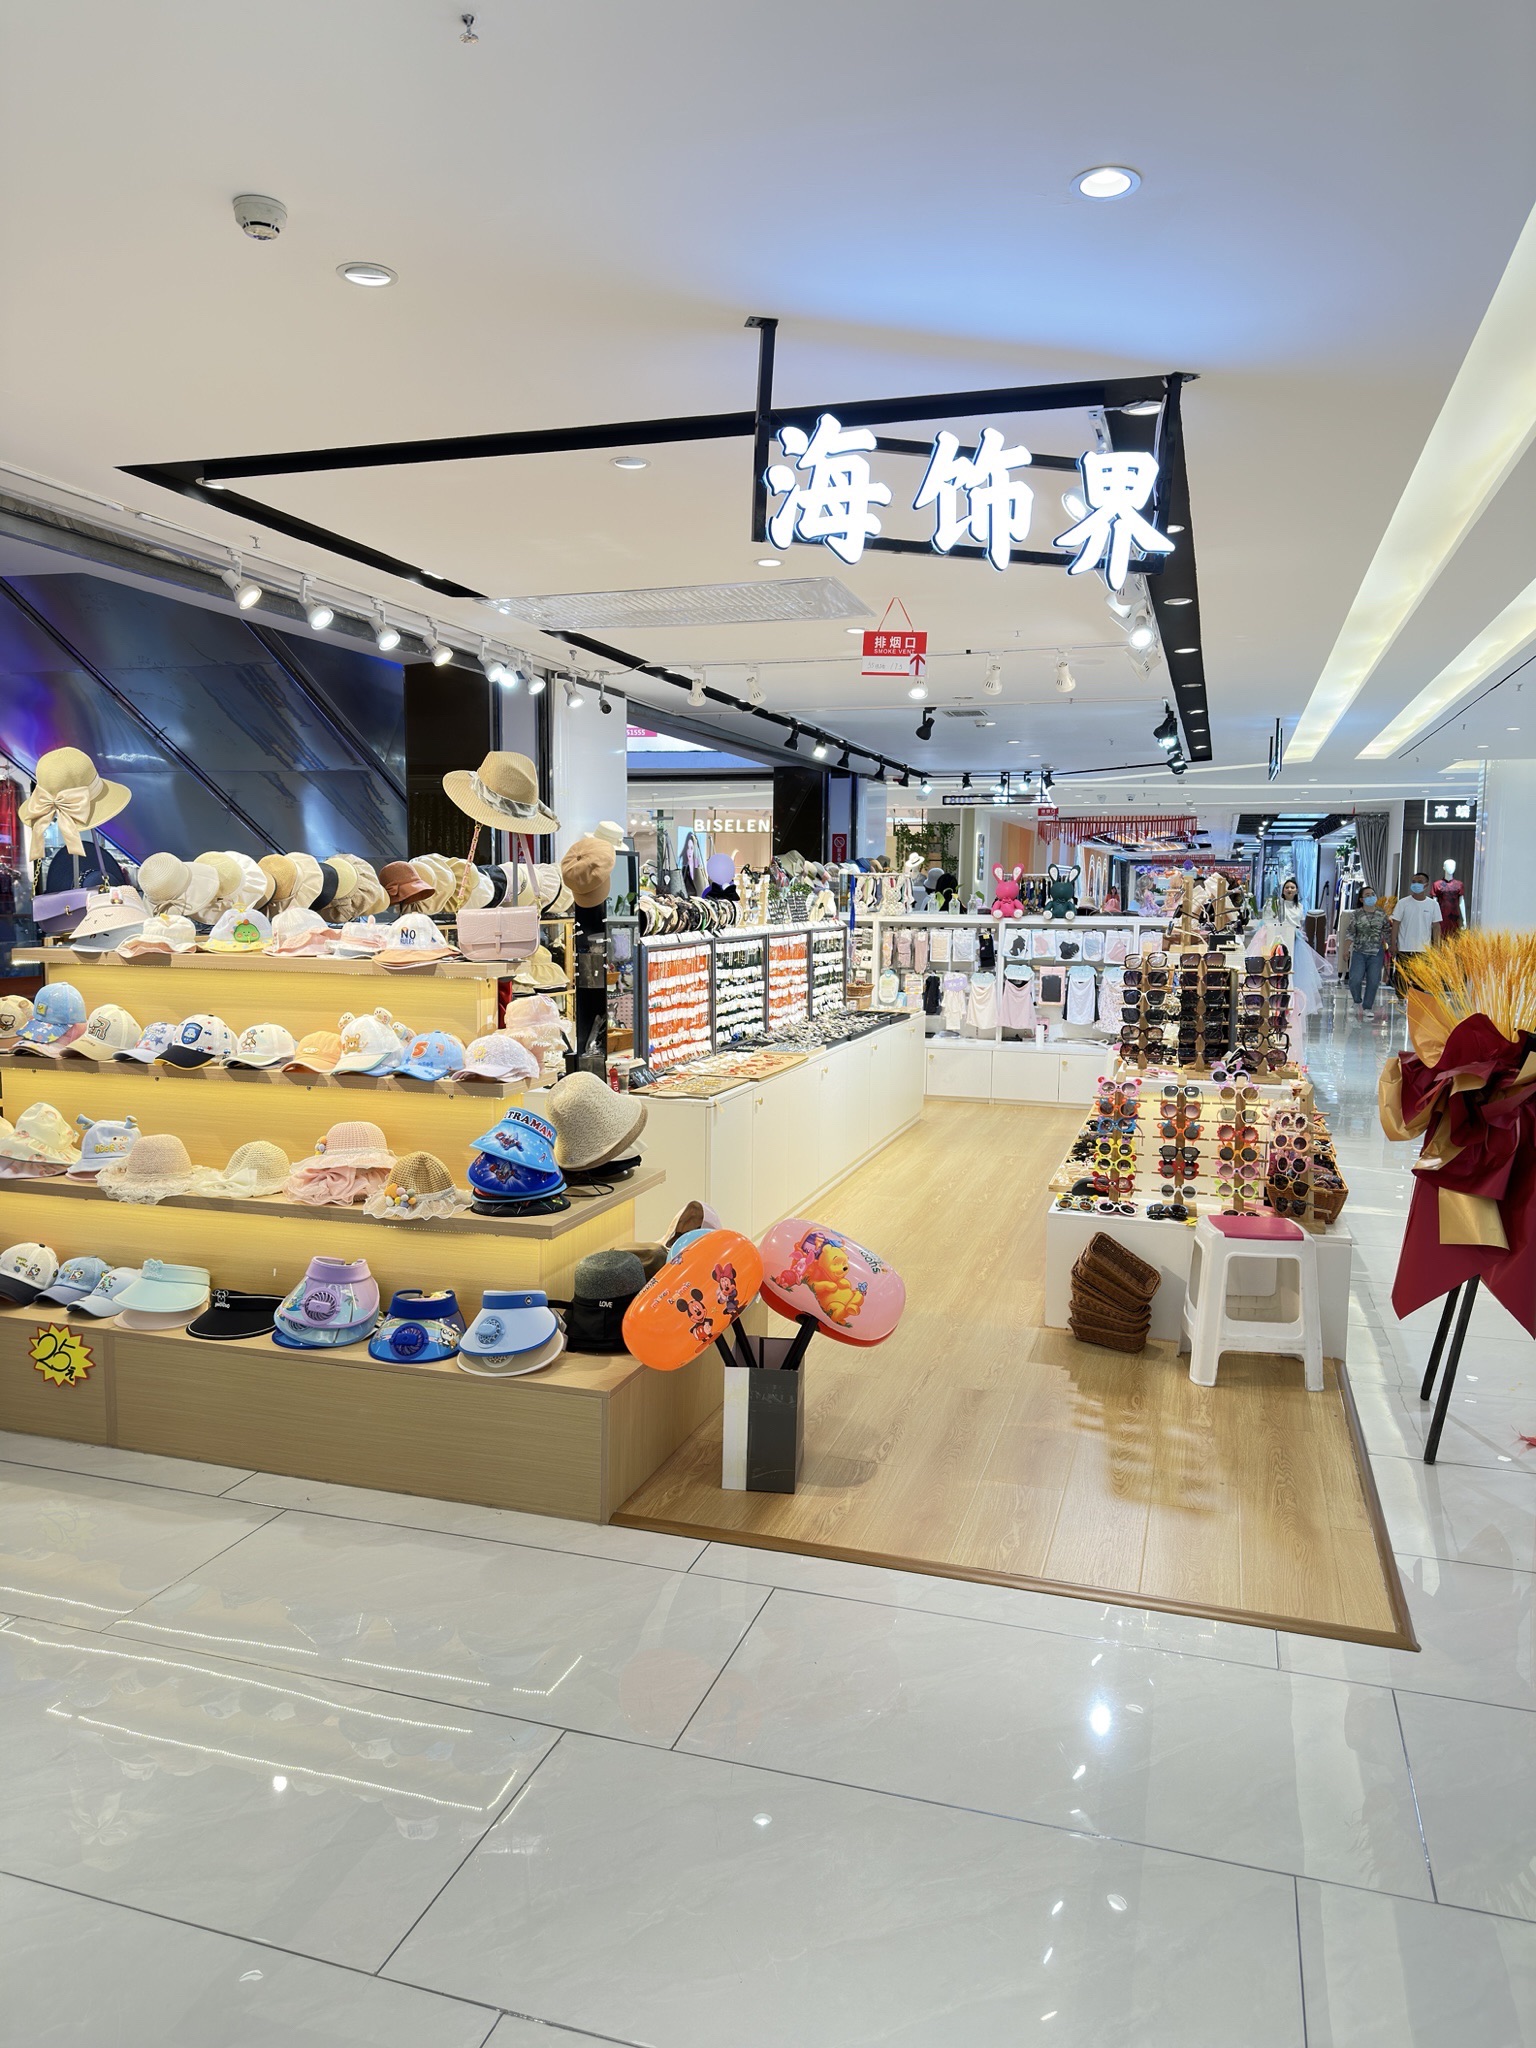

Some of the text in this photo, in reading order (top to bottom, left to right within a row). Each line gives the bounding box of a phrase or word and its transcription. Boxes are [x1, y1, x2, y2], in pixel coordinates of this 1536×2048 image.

[763, 413, 1175, 592] 海饰界
[874, 636, 916, 649] 排烟口
[694, 818, 774, 832] BISELEN
[401, 928, 416, 939] NO
[411, 1041, 430, 1059] 5
[504, 1110, 555, 1140] TRAMAN
[598, 1300, 613, 1309] LOVE
